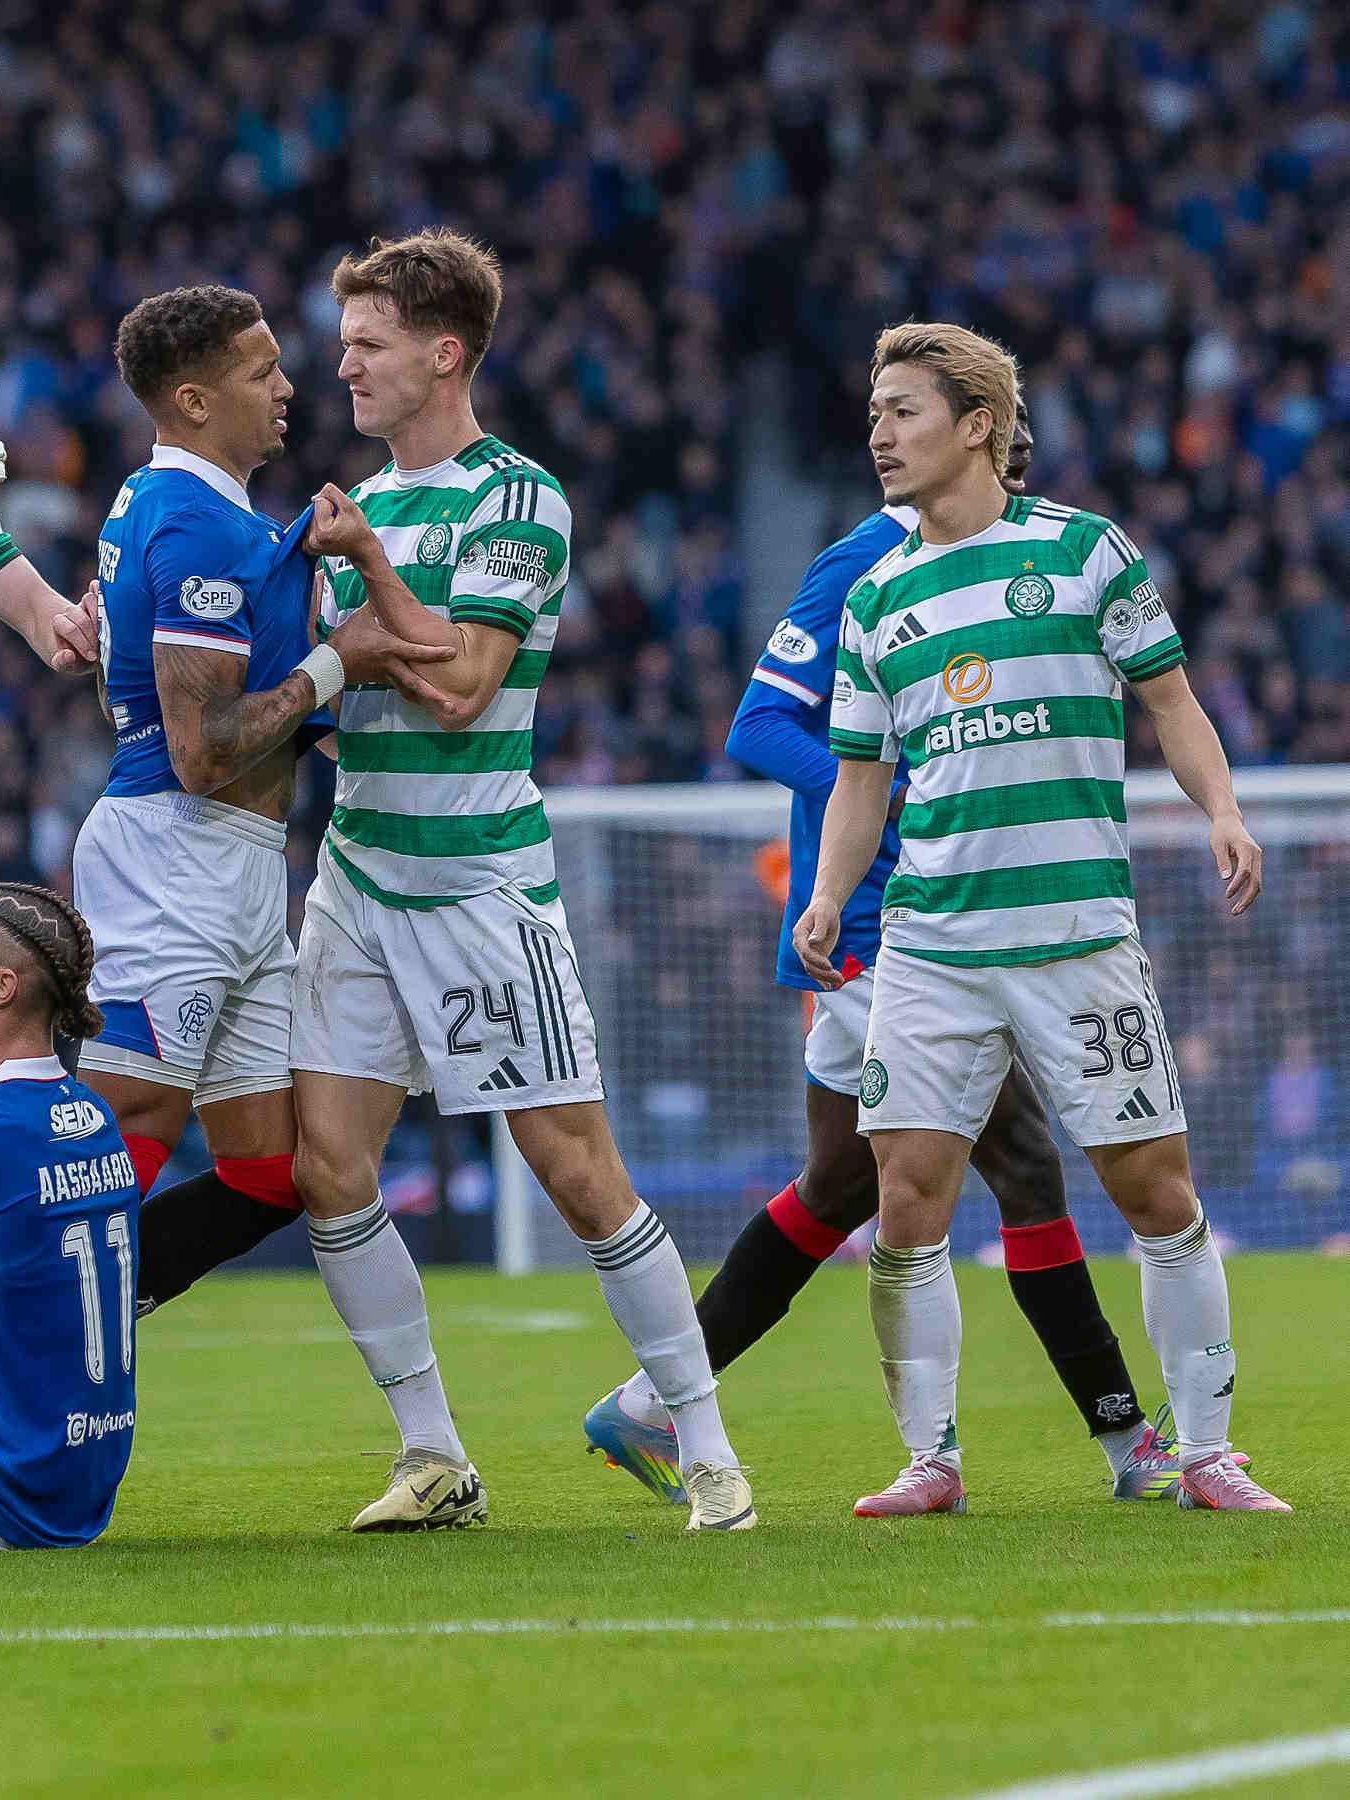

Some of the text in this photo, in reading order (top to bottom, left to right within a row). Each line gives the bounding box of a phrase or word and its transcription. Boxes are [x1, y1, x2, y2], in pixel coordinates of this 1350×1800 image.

[488, 540, 547, 567] CELTIC FC
[200, 591, 234, 605] SPFL
[777, 632, 807, 655] SPFL
[441, 979, 527, 1057] 24
[1069, 1005, 1154, 1079] 38
[38, 1151, 136, 1205] AASGAARD
[61, 1211, 135, 1384] 11
